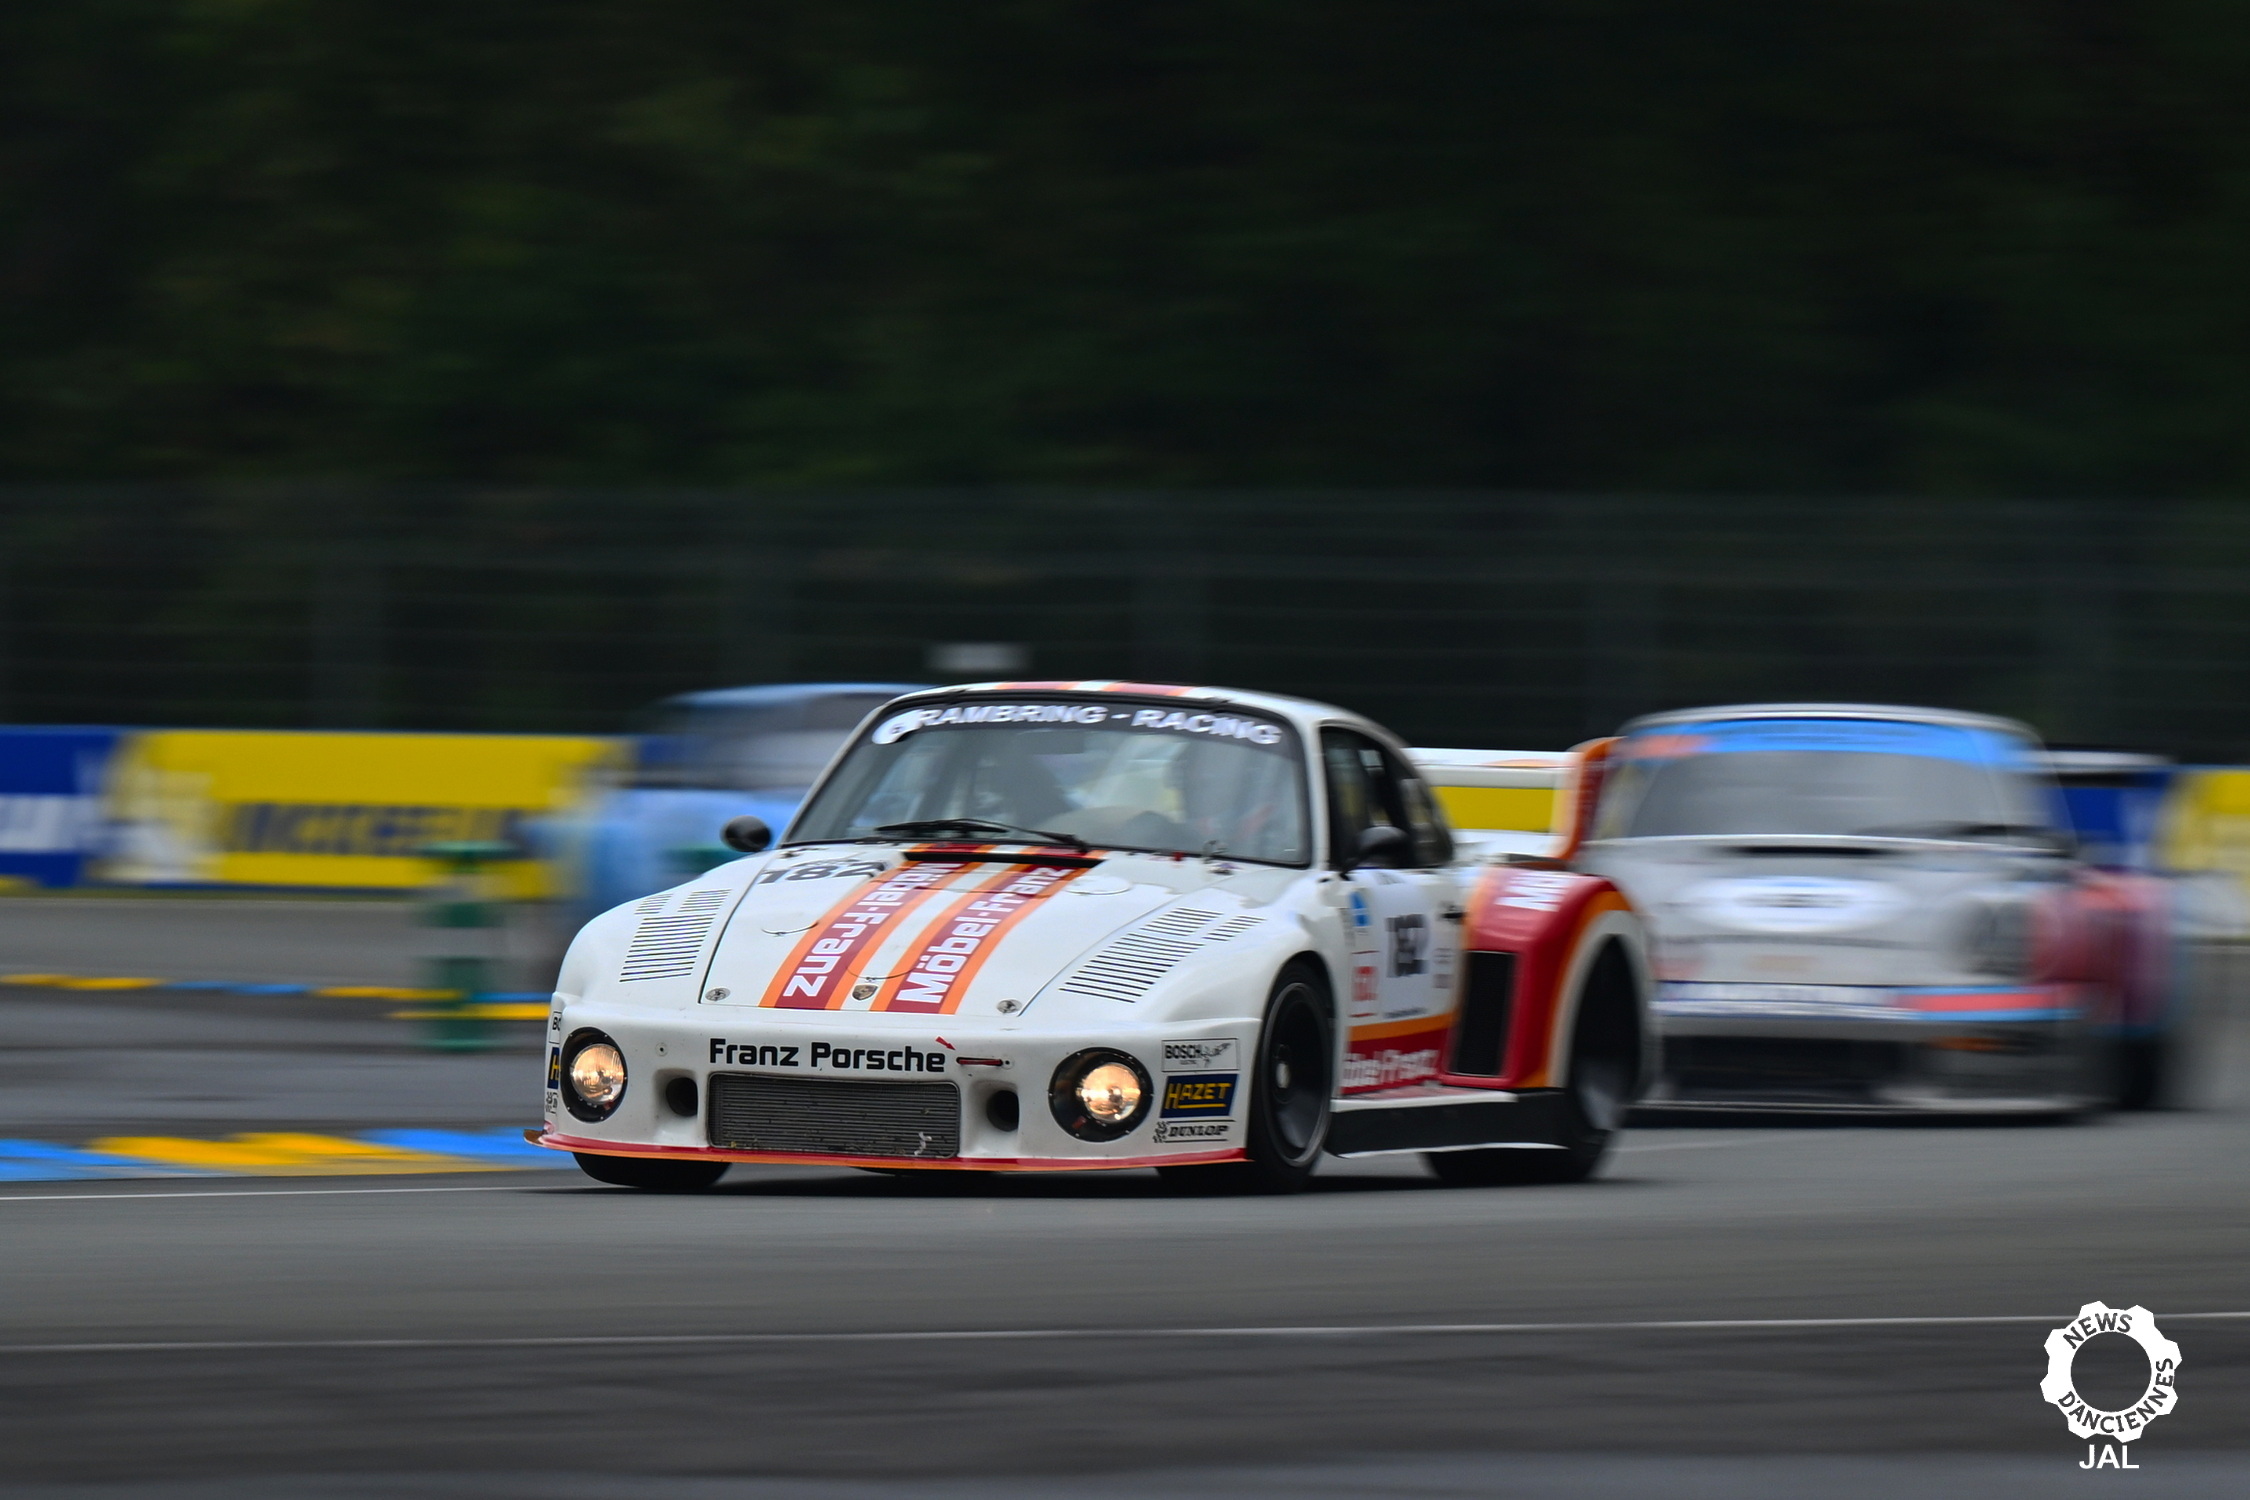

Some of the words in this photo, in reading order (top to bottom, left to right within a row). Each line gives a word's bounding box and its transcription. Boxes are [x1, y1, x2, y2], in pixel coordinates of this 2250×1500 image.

[1131, 709, 1282, 745] RACING
[758, 861, 885, 884] 182
[896, 867, 1075, 1003] Möbel-Franz
[710, 1038, 799, 1066] Franz
[811, 1042, 945, 1072] Porsche
[1165, 1044, 1202, 1059] BOSCH
[1164, 1082, 1232, 1109] HAZET
[1167, 1125, 1228, 1137] DUNLOP
